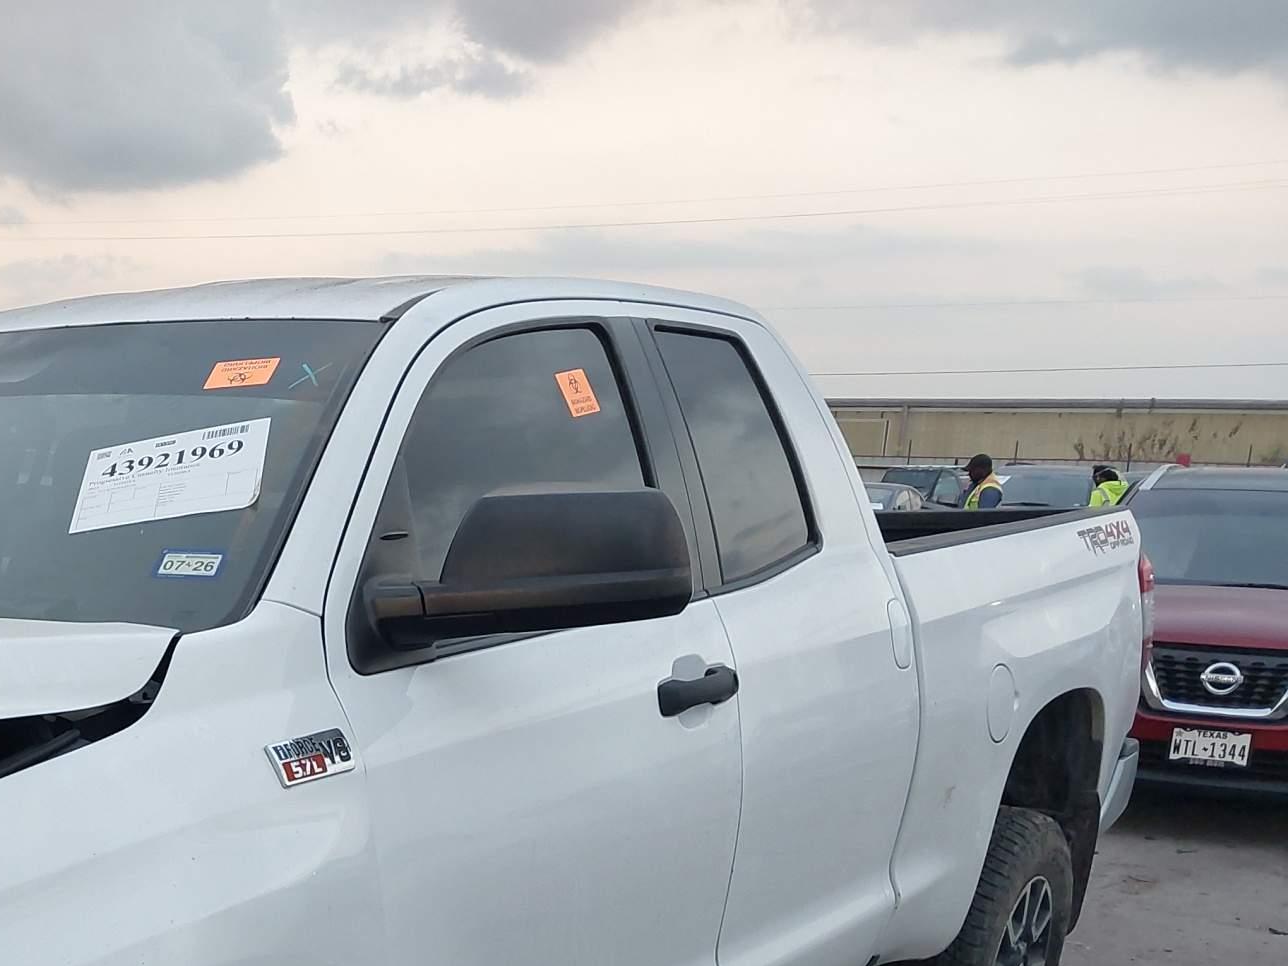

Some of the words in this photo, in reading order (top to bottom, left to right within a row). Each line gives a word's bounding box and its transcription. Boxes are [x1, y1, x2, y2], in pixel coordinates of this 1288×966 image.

[101, 439, 244, 478] 43921969
[162, 559, 186, 571] 07
[193, 559, 216, 572] 26
[1197, 729, 1228, 740] TEXAS
